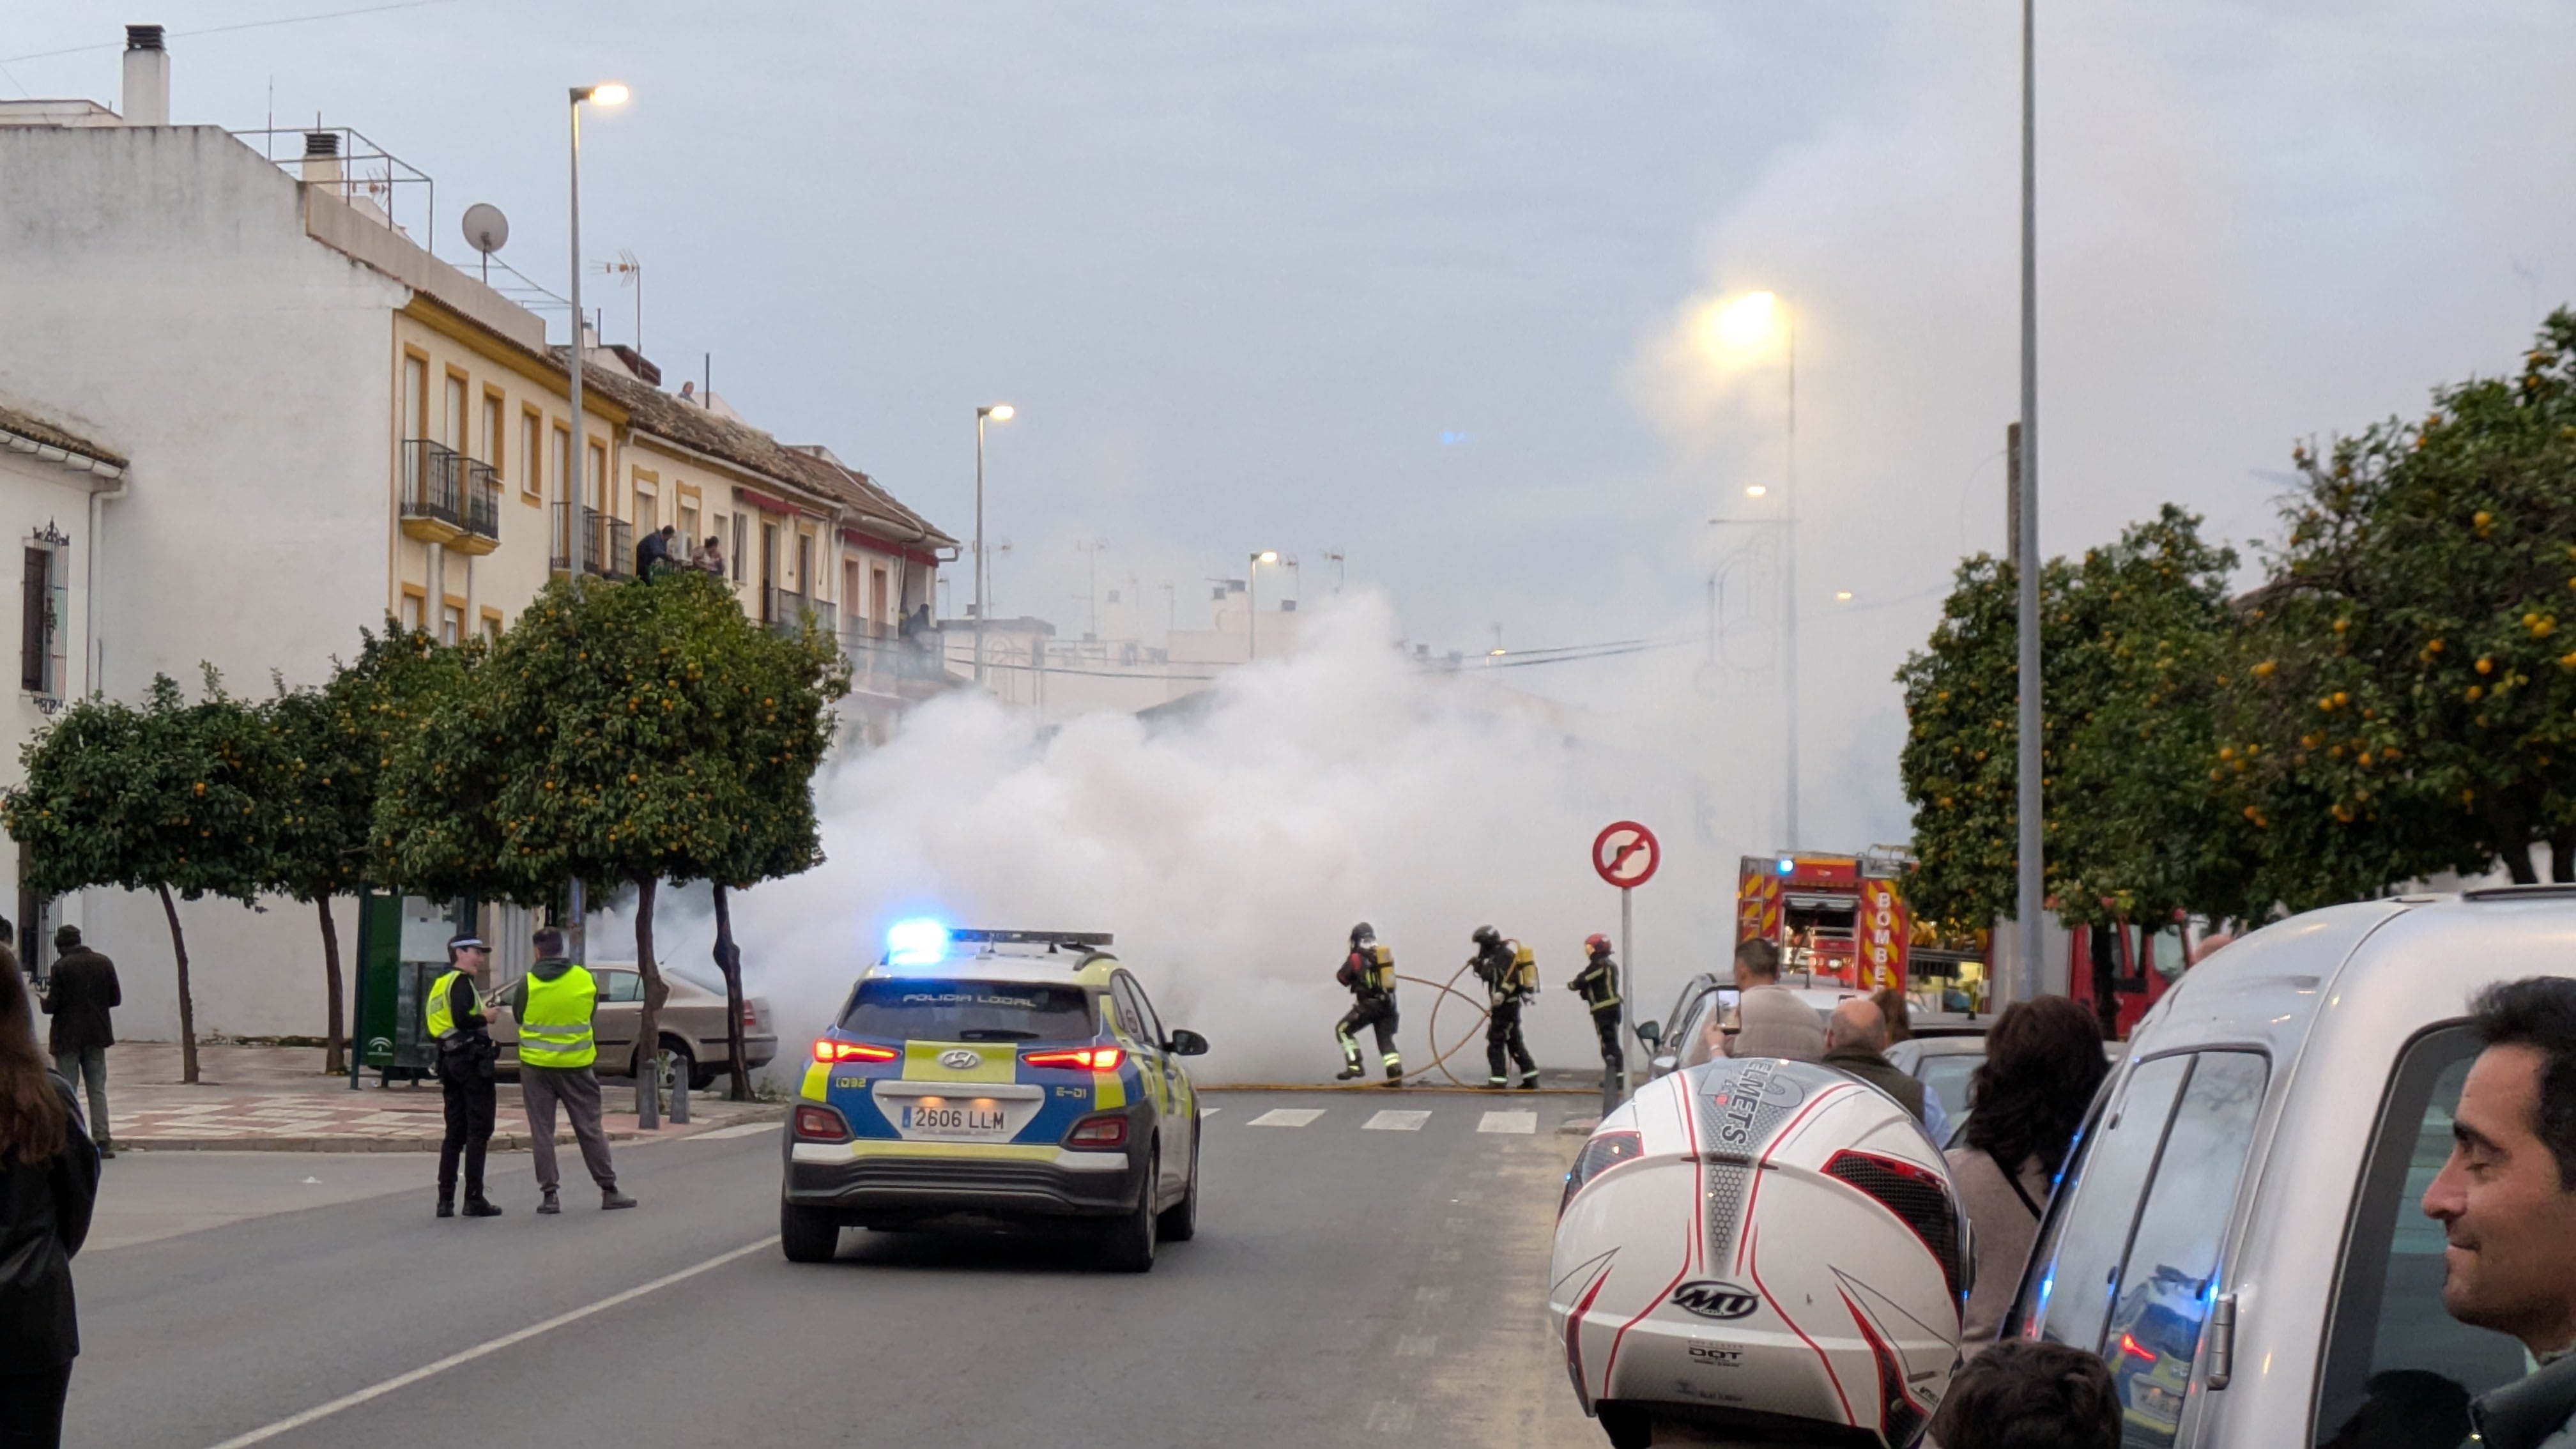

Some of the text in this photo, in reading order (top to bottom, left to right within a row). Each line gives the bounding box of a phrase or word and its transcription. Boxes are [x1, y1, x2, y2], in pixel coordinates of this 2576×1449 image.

[903, 993, 1038, 1008] POLICIA LOCAL
[1721, 1061, 1774, 1145] ELMETS
[916, 1108, 1004, 1130] 2606 LLM
[1689, 1347, 1743, 1360] DOT
